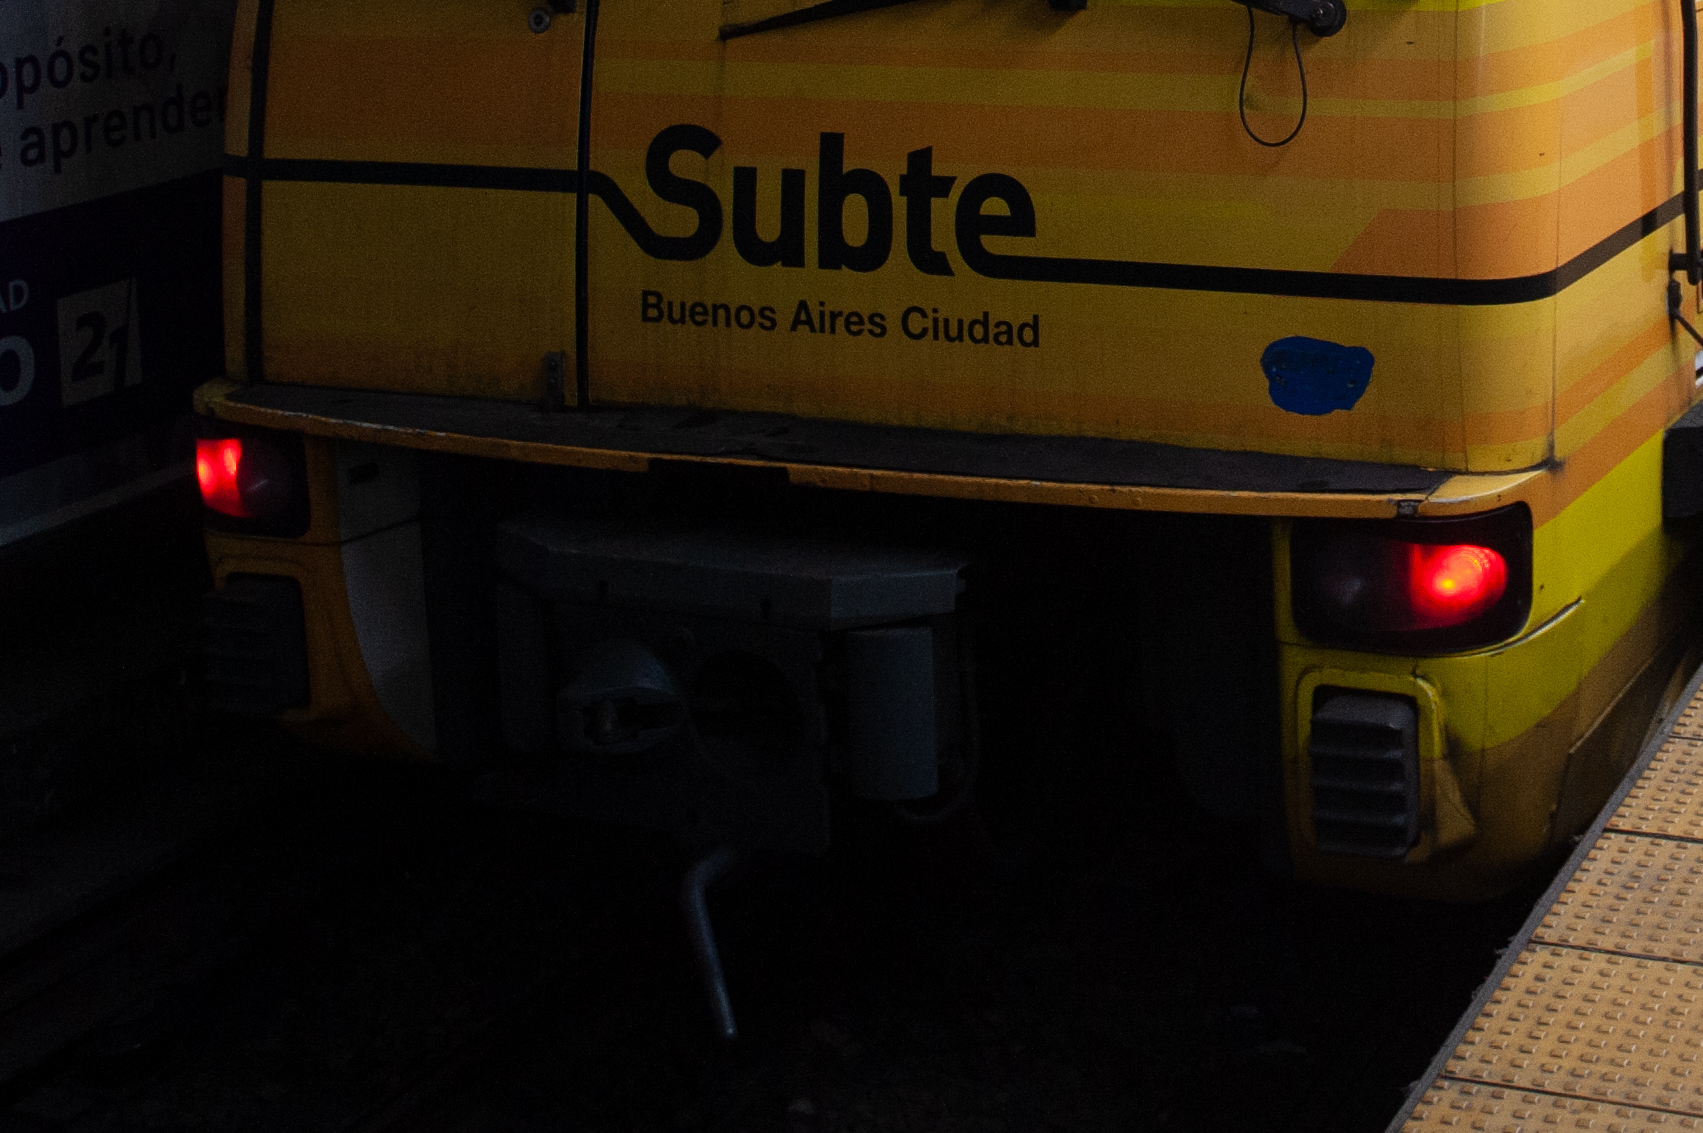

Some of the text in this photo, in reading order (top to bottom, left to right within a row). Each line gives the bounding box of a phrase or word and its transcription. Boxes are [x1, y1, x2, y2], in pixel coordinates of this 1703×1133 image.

[0, 26, 176, 110] pósito,
[645, 123, 1037, 283] Subte
[641, 289, 1041, 348] Buenos Aires Ciudad
